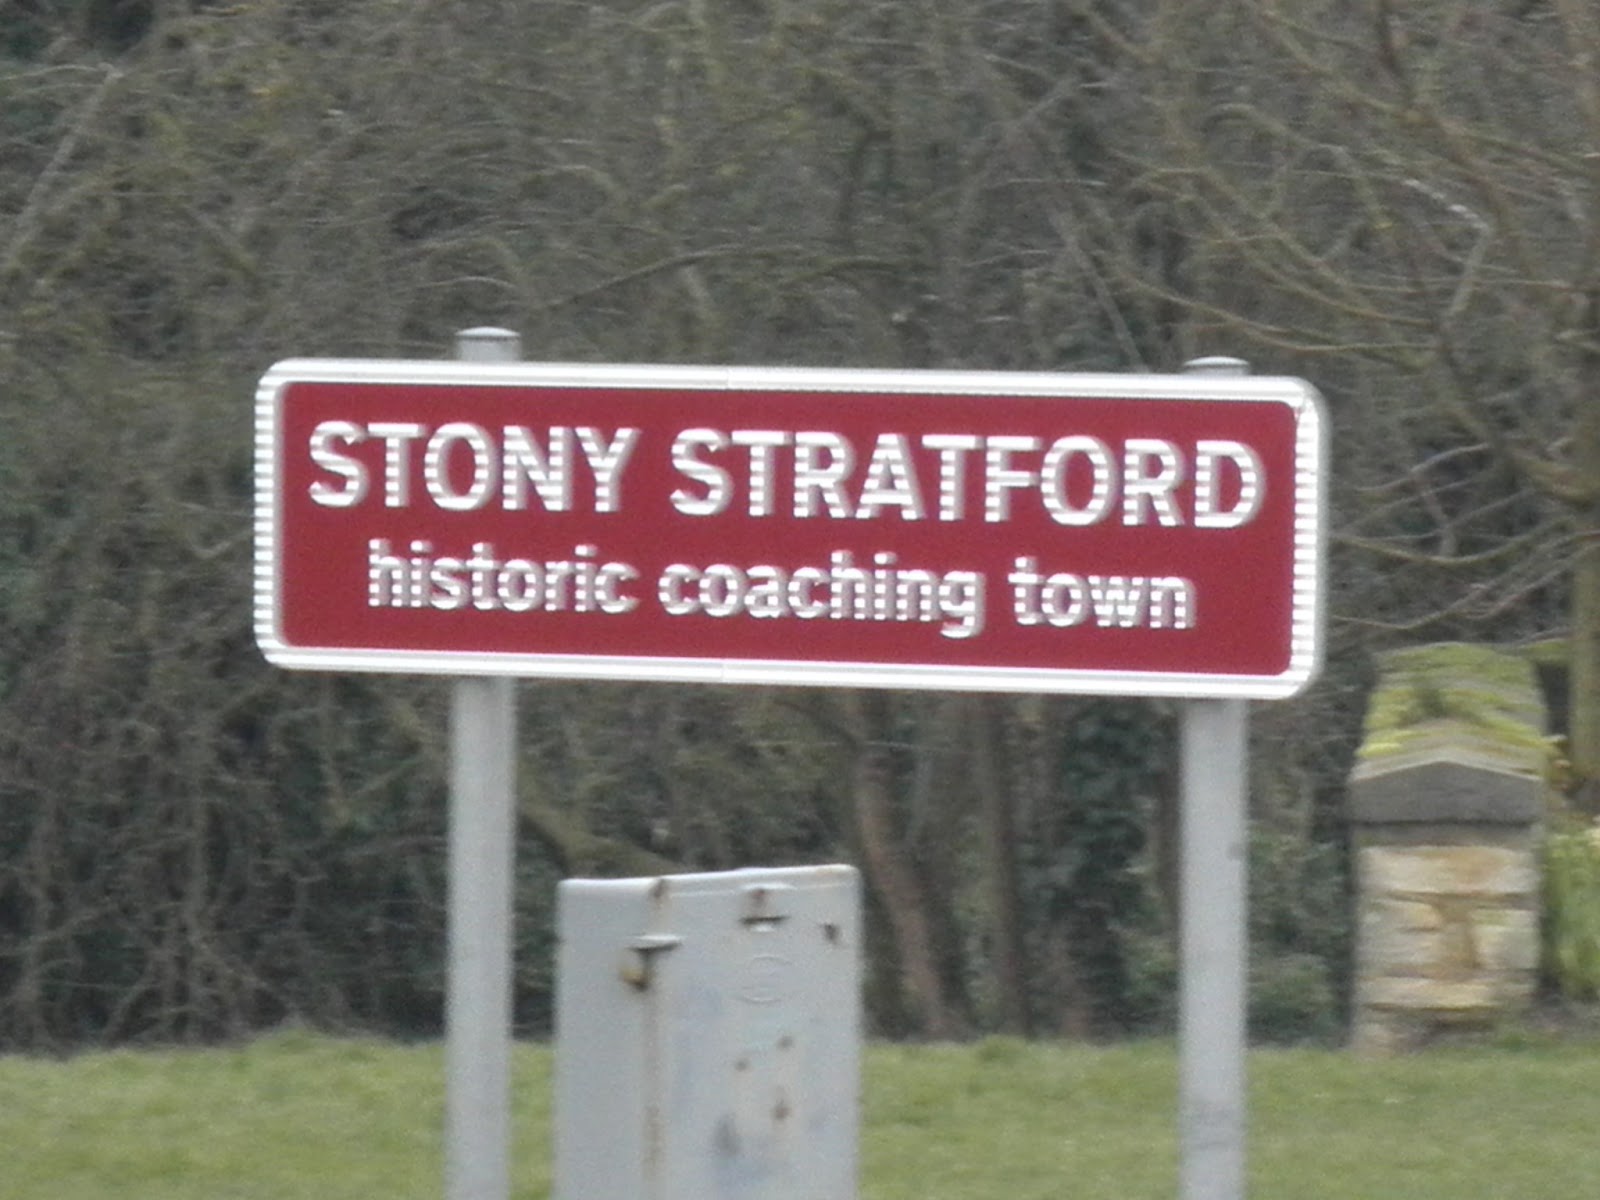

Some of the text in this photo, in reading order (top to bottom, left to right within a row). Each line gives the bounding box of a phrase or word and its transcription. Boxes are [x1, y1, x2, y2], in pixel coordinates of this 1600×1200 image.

[309, 420, 1265, 530] STONY STRATFORD
[368, 538, 1195, 639] historic coaching town
